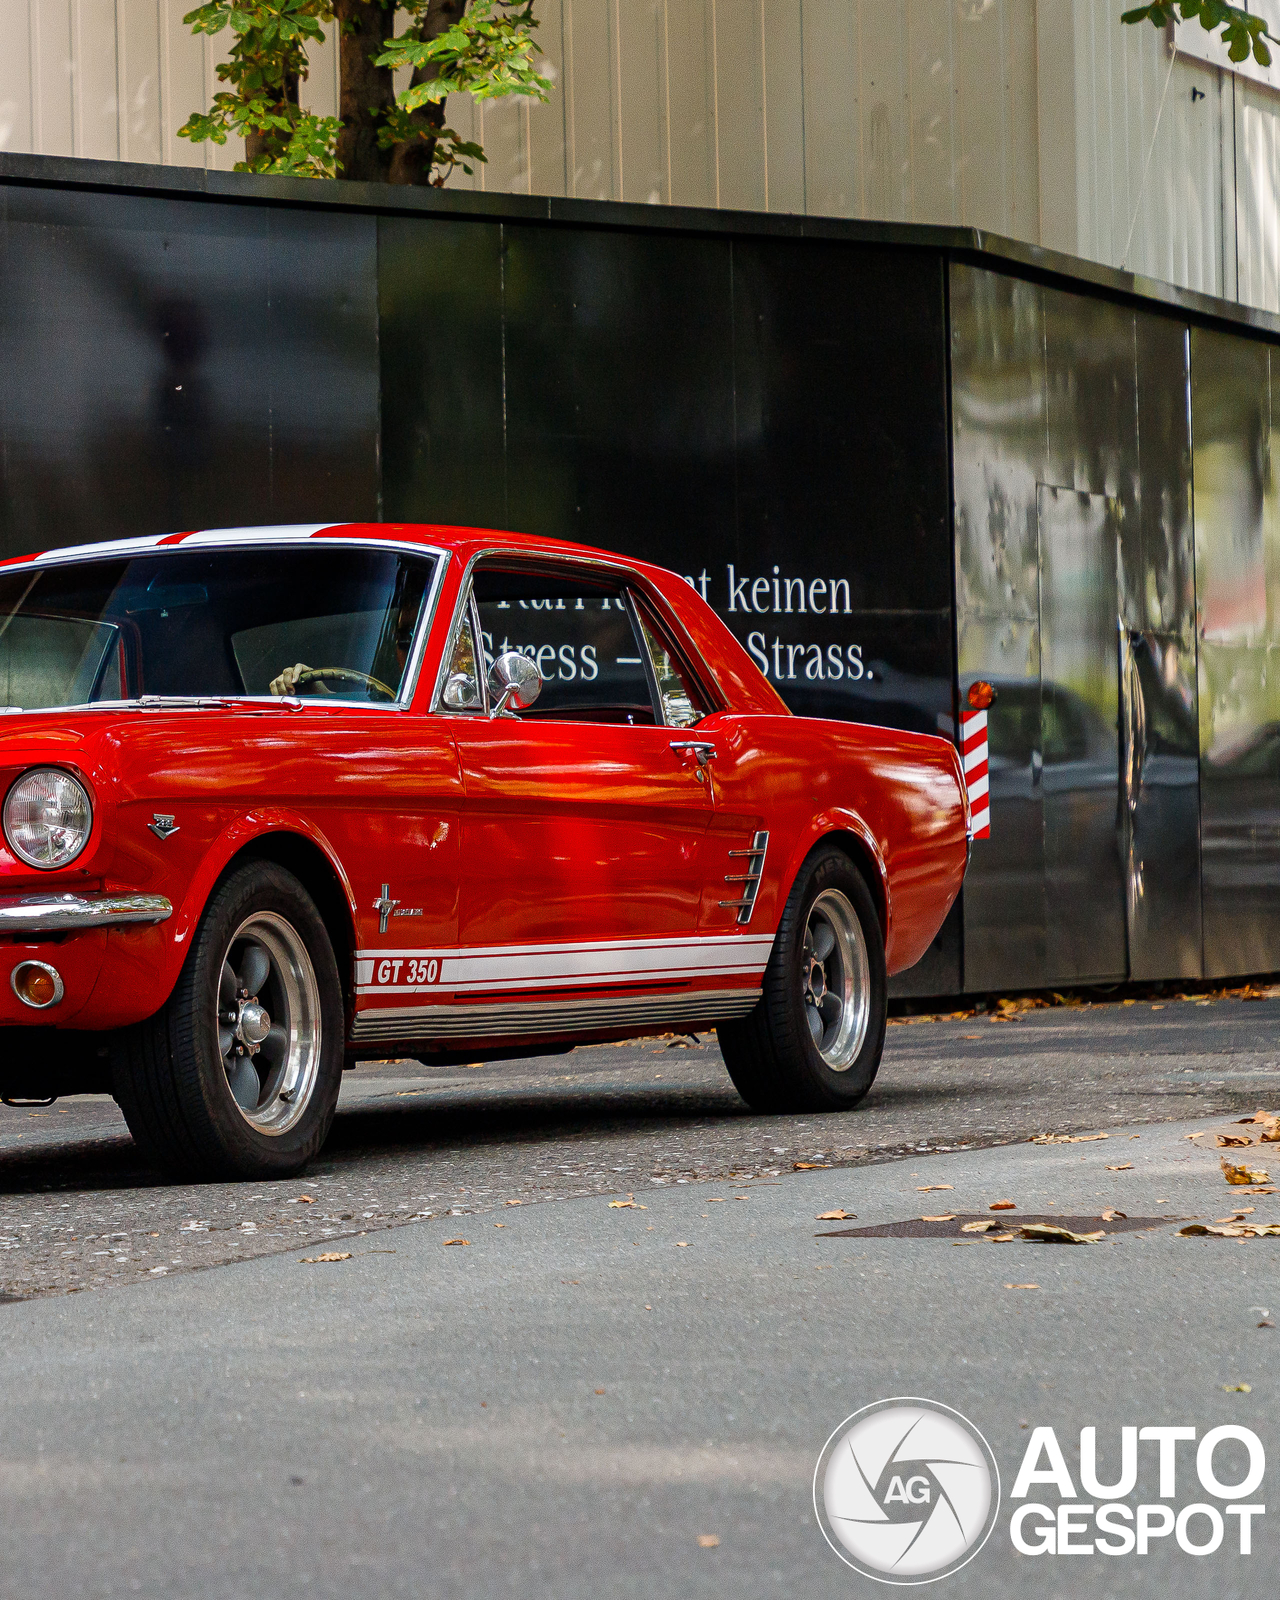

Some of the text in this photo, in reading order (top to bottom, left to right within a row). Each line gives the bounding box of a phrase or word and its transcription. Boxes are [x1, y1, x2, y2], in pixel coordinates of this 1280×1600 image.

[727, 564, 852, 614] keinen
[747, 631, 874, 680] Strass.
[377, 959, 438, 984] GT 350
